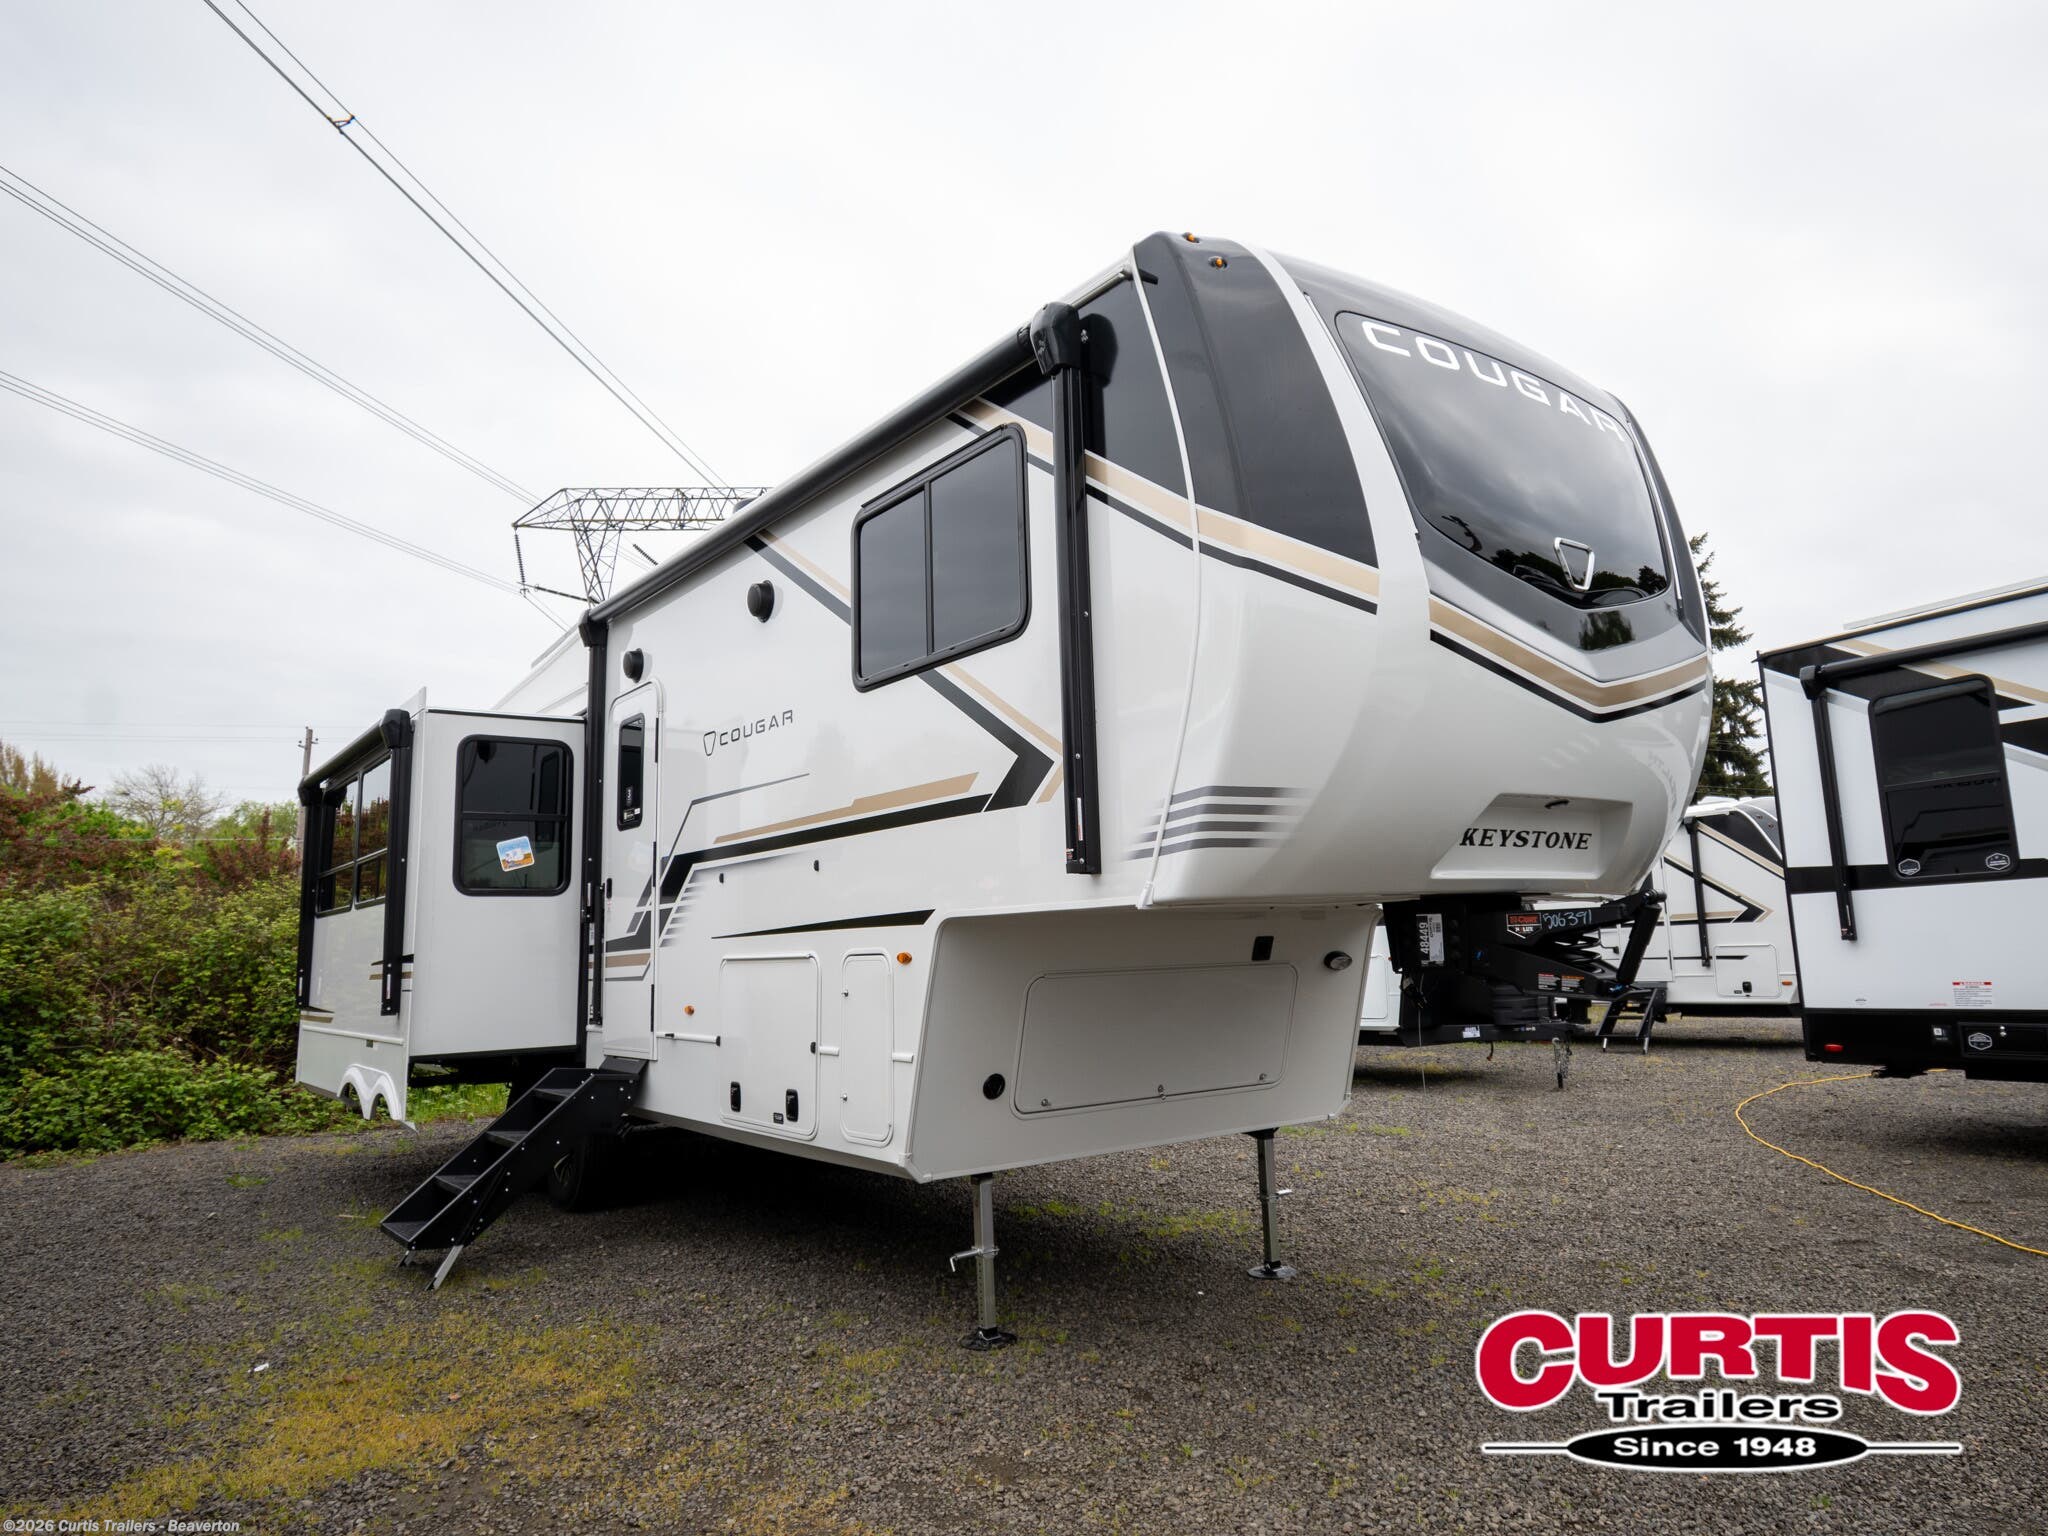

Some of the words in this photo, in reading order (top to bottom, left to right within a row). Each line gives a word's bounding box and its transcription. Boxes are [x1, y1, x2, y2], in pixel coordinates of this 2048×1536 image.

[1362, 320, 1625, 442] COUGAR
[719, 709, 793, 746] COUGAR
[1459, 828, 1592, 850] KEYSTONE
